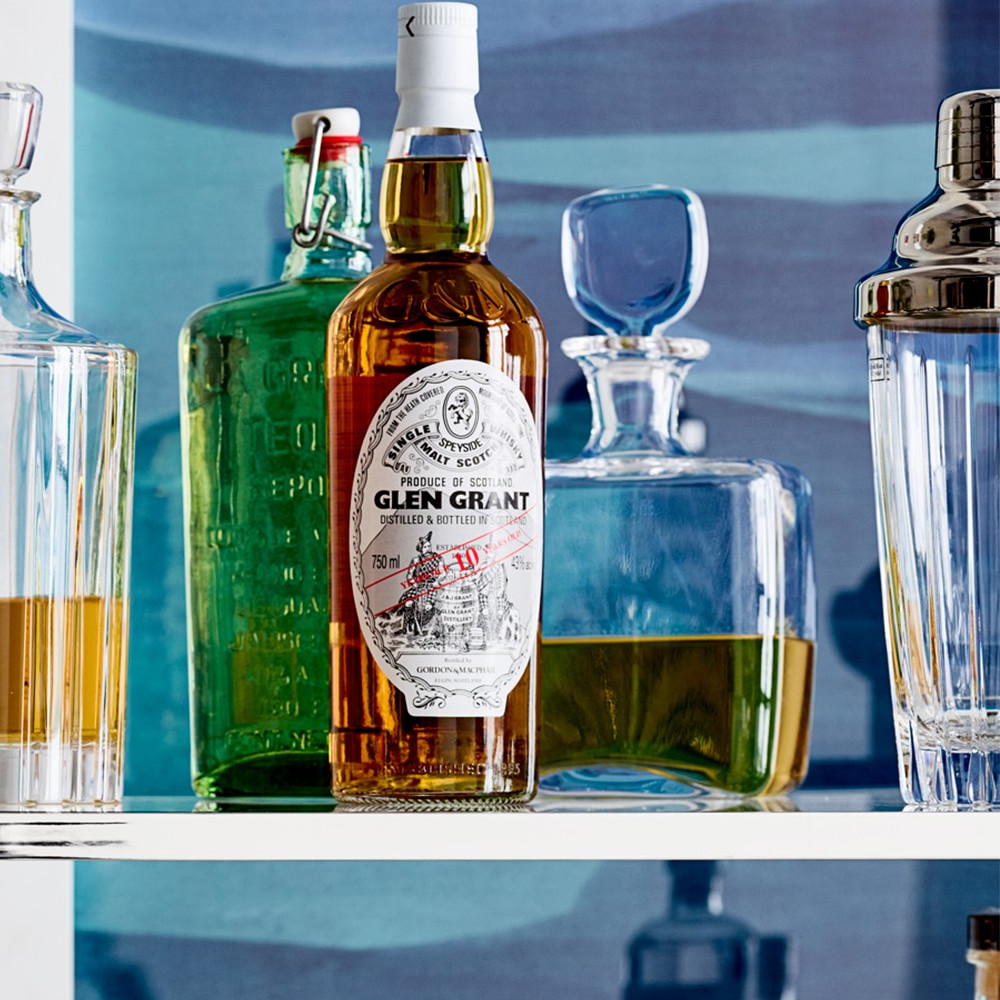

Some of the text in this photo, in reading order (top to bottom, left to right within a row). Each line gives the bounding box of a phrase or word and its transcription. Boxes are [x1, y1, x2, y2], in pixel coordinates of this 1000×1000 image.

[386, 386, 444, 436] FROM THE HEATH COVERED
[388, 424, 431, 460] SINGLE
[439, 438, 483, 453] SPEYSIDE
[420, 442, 450, 466] MALT
[401, 477, 446, 487] PRODUCE
[452, 477, 464, 487] OF
[374, 490, 530, 511] GLEN GRANT
[380, 514, 423, 525] DISTILLED
[426, 515, 433, 525] &
[436, 515, 476, 525] BOTTLED
[479, 515, 487, 525] IN
[372, 554, 400, 570] 750 ml
[454, 546, 480, 572] 10
